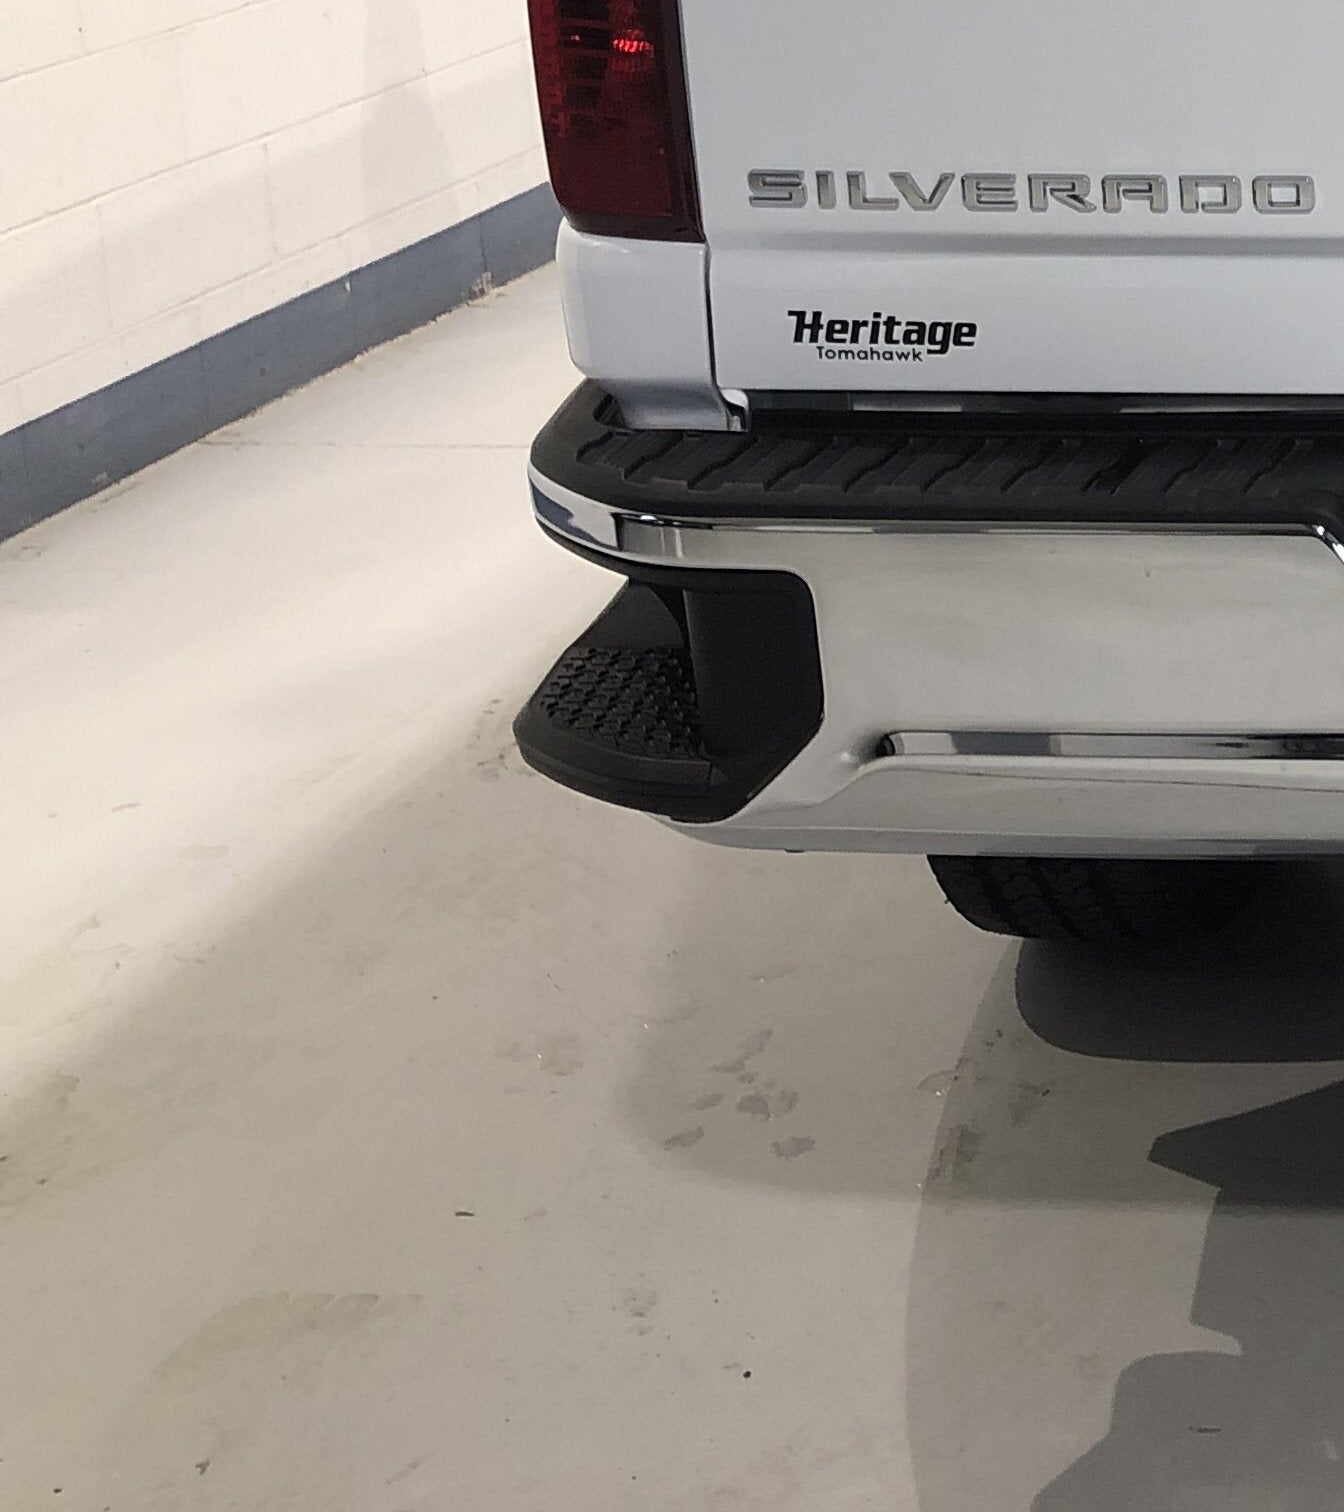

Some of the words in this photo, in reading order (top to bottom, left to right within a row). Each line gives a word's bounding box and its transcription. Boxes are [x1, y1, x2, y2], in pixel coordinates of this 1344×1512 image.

[746, 169, 1317, 215] SILVERADO
[788, 310, 978, 355] Heritage
[816, 346, 924, 363] Tomahawk
